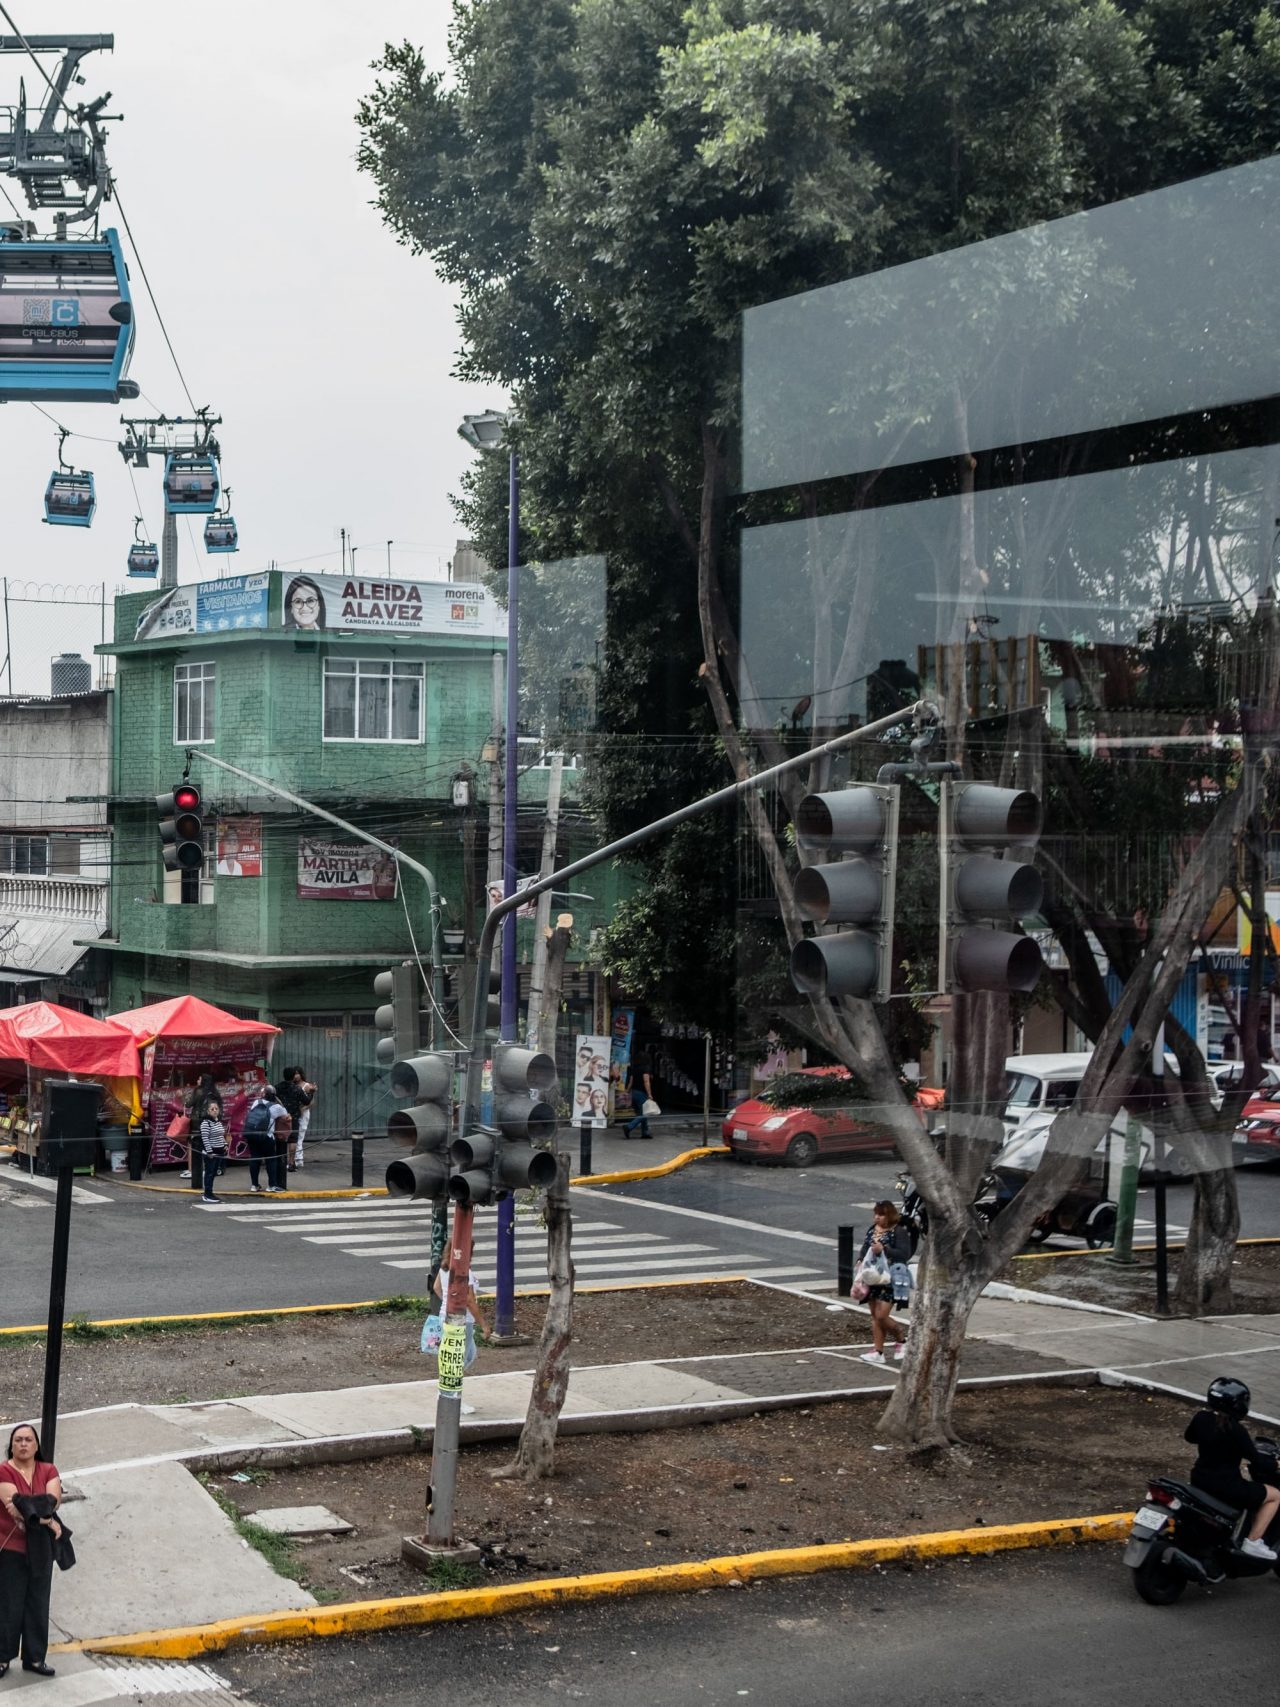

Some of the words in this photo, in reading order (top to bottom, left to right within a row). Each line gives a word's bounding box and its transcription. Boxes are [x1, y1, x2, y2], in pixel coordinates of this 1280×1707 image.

[342, 581, 422, 602] ALEIDA
[445, 590, 484, 600] morena
[342, 601, 422, 621] ALAVEZ
[453, 610, 463, 619] PT
[303, 858, 371, 871] MARTHA
